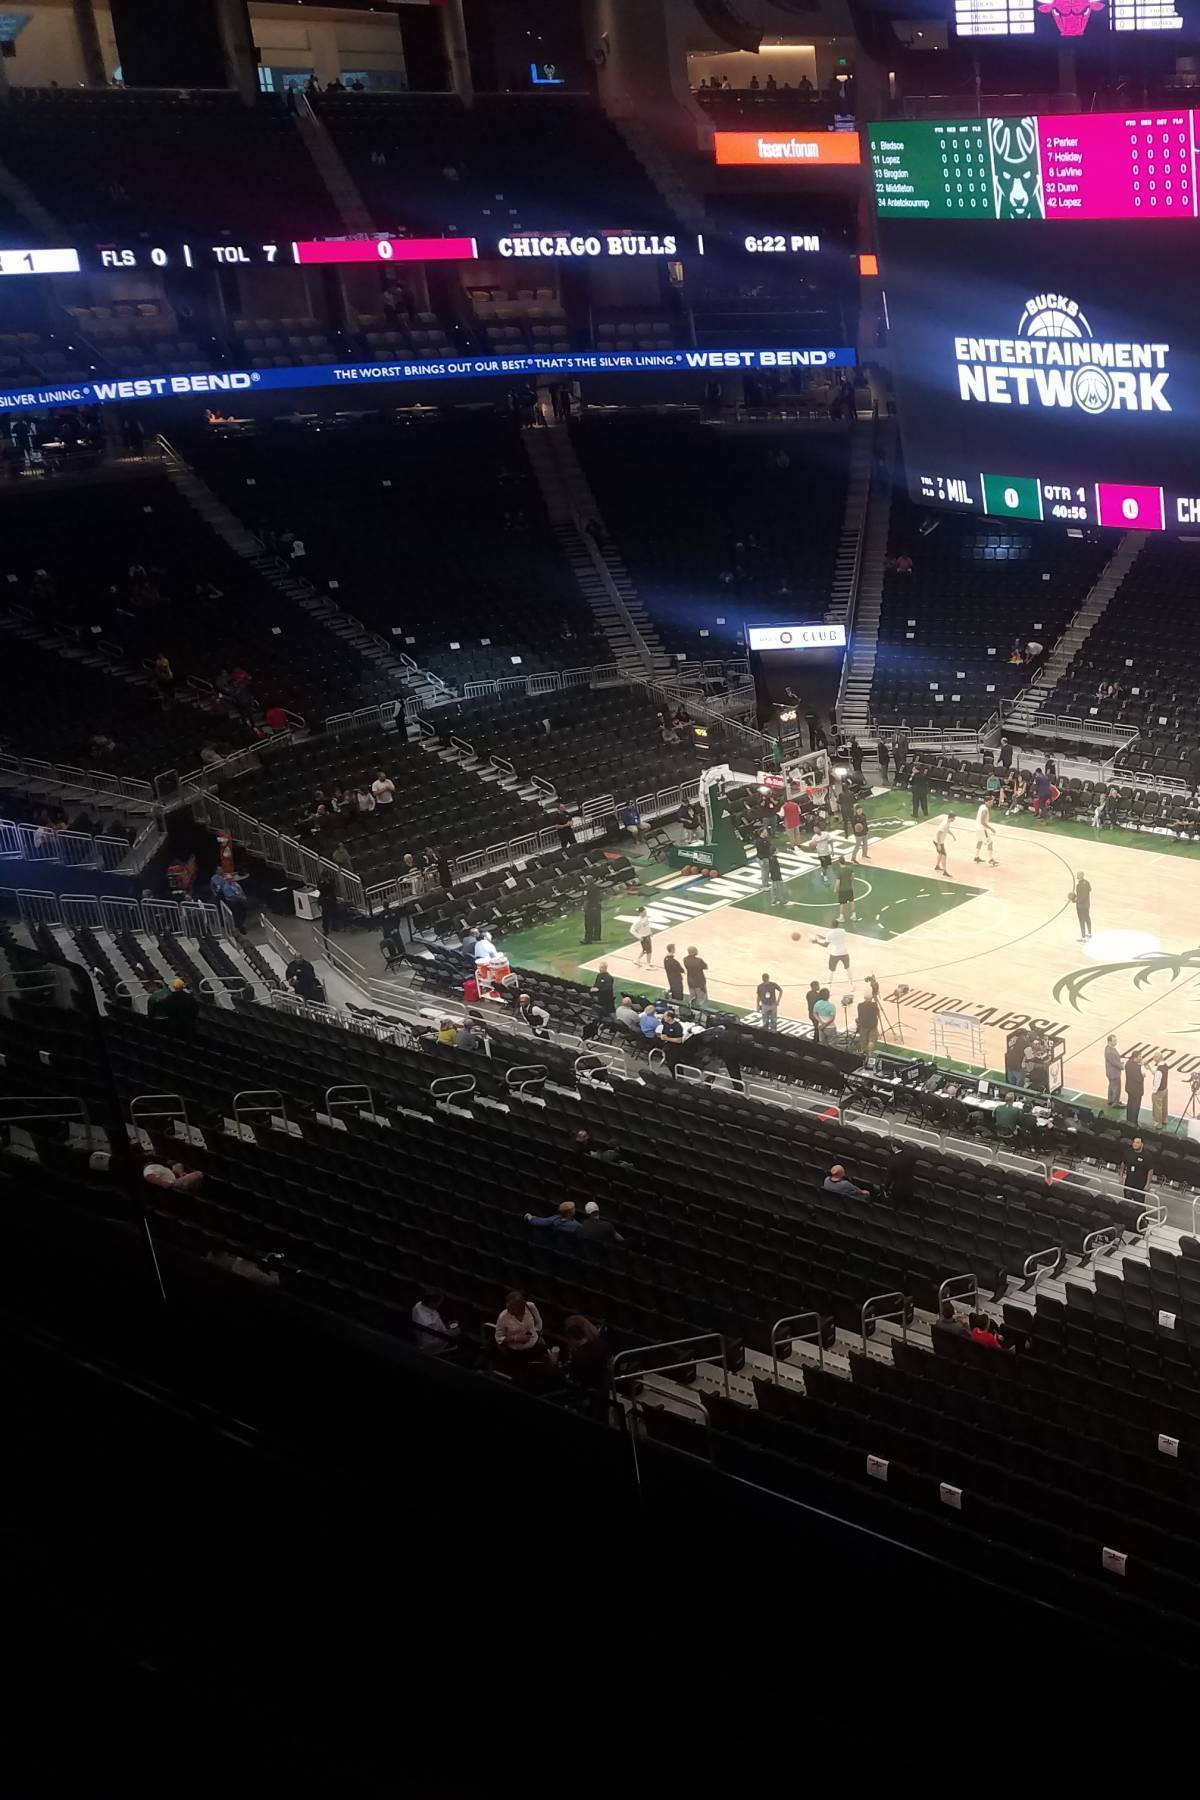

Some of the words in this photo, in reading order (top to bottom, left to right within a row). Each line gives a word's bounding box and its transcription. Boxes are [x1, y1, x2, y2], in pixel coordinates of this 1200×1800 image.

[1053, 137, 1078, 148] Parker
[882, 155, 900, 165] Lopez
[1054, 152, 1082, 163] Holiday
[883, 169, 909, 180] Brogdon
[1056, 166, 1083, 177] LaVine
[876, 184, 885, 192] 22
[885, 183, 914, 193] Middleton
[1046, 183, 1056, 193] 32
[1058, 182, 1078, 193] Dunn
[878, 198, 886, 207] 34
[1058, 197, 1082, 208] Lopez
[377, 240, 393, 259] 0
[498, 236, 601, 257] CHICAGO
[607, 236, 677, 255] BULLS
[745, 236, 786, 252] 6:22
[791, 236, 820, 252] PM
[23, 253, 35, 271] 1
[102, 250, 136, 267] FLS
[151, 248, 167, 266] 0
[213, 246, 250, 263] TOL
[262, 245, 278, 262] 7
[1025, 294, 1079, 318] BUCKS
[955, 338, 1170, 368] ENTERTAINMENT
[334, 369, 358, 380] THE
[359, 366, 401, 378] WORST
[404, 364, 446, 376] BRINGS
[447, 362, 472, 374] OUT
[475, 361, 500, 372] OUR
[534, 357, 573, 369] THAT'S
[576, 356, 597, 367] THE
[599, 356, 634, 367] SILVER
[686, 352, 755, 367] WEST
[93, 378, 167, 400] WEST
[957, 365, 1172, 414] NETWORK
[947, 479, 973, 503] MIL
[1004, 488, 1019, 508] 0
[1044, 486, 1071, 500] QTR
[1077, 488, 1085, 501] 1
[1052, 505, 1087, 519] 40:56
[1122, 498, 1139, 519] 0
[803, 631, 837, 641] CLUB
